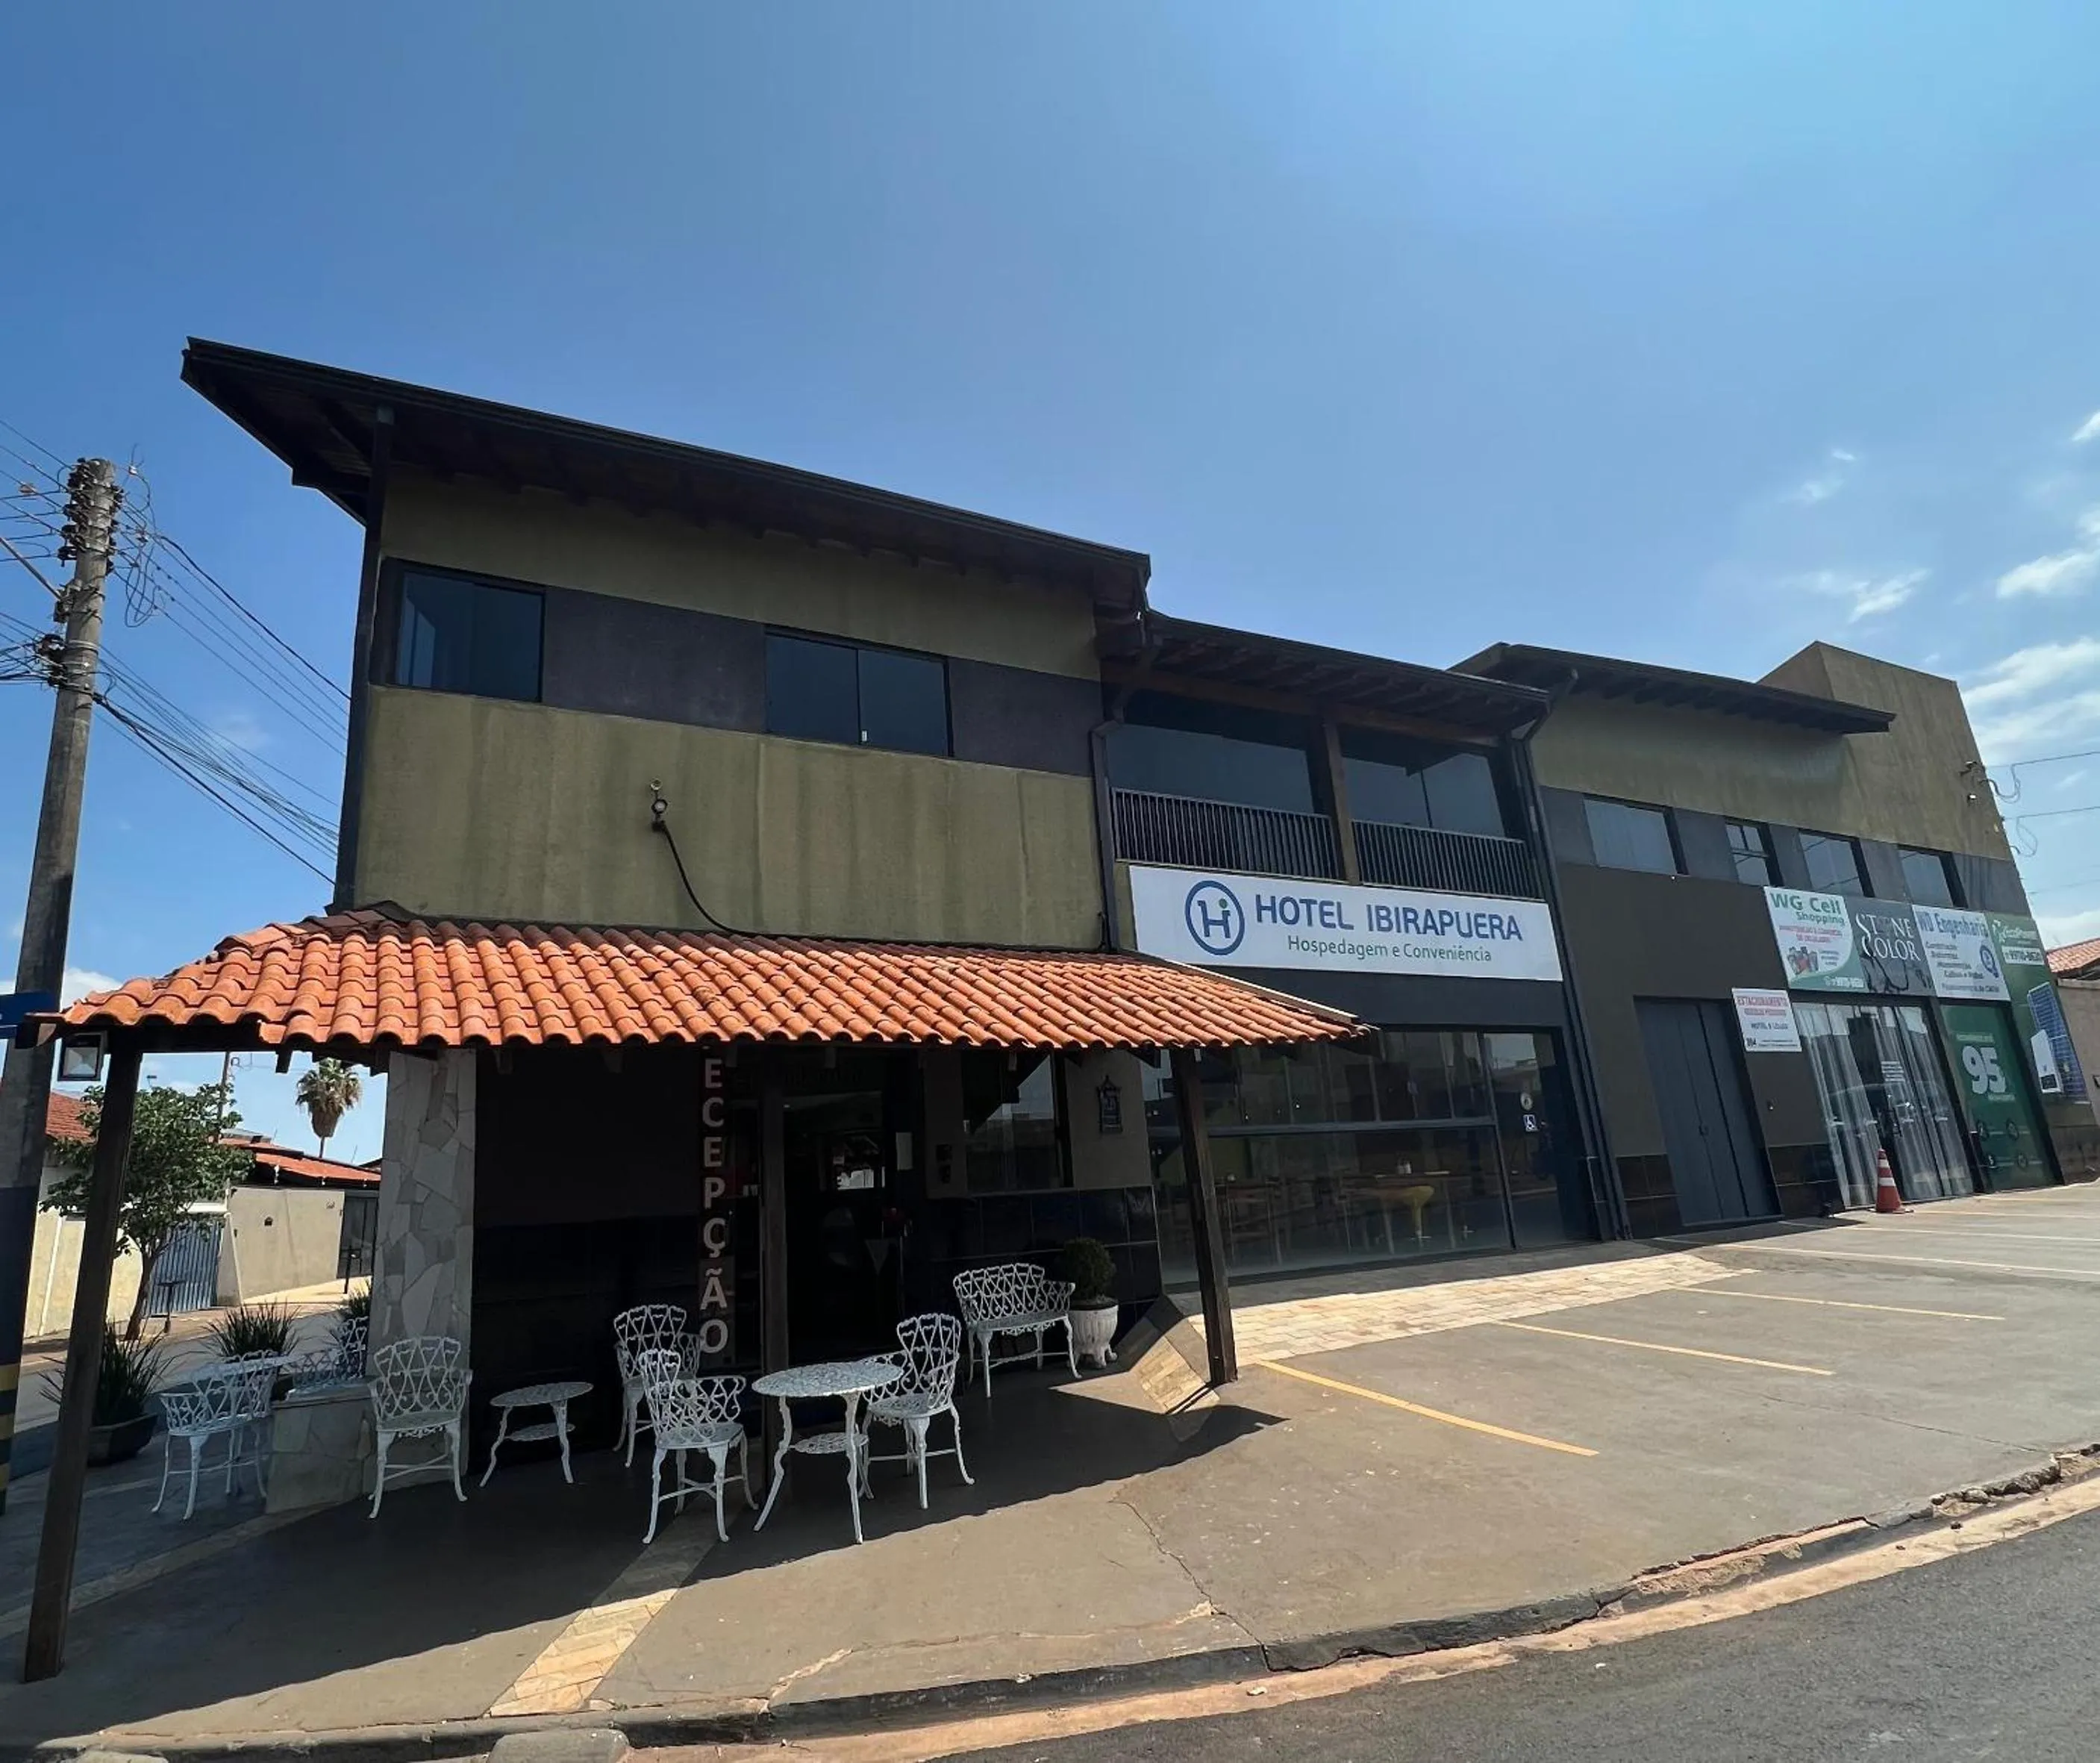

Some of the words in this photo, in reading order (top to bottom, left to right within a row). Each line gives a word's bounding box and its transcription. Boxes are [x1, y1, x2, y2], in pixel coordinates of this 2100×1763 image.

[1770, 893, 1803, 910] WG
[1810, 897, 1841, 914] Cell
[1255, 894, 1354, 931] HOTEL
[1366, 904, 1523, 941] IBIRAPUERA
[1796, 911, 1846, 926] Shopping
[1855, 913, 1915, 943] STNE
[1288, 935, 1388, 960] Hospedagem
[1392, 946, 1400, 958] e
[1861, 935, 1922, 961] COLOR
[700, 1048, 728, 1354] ECEPÇÃO
